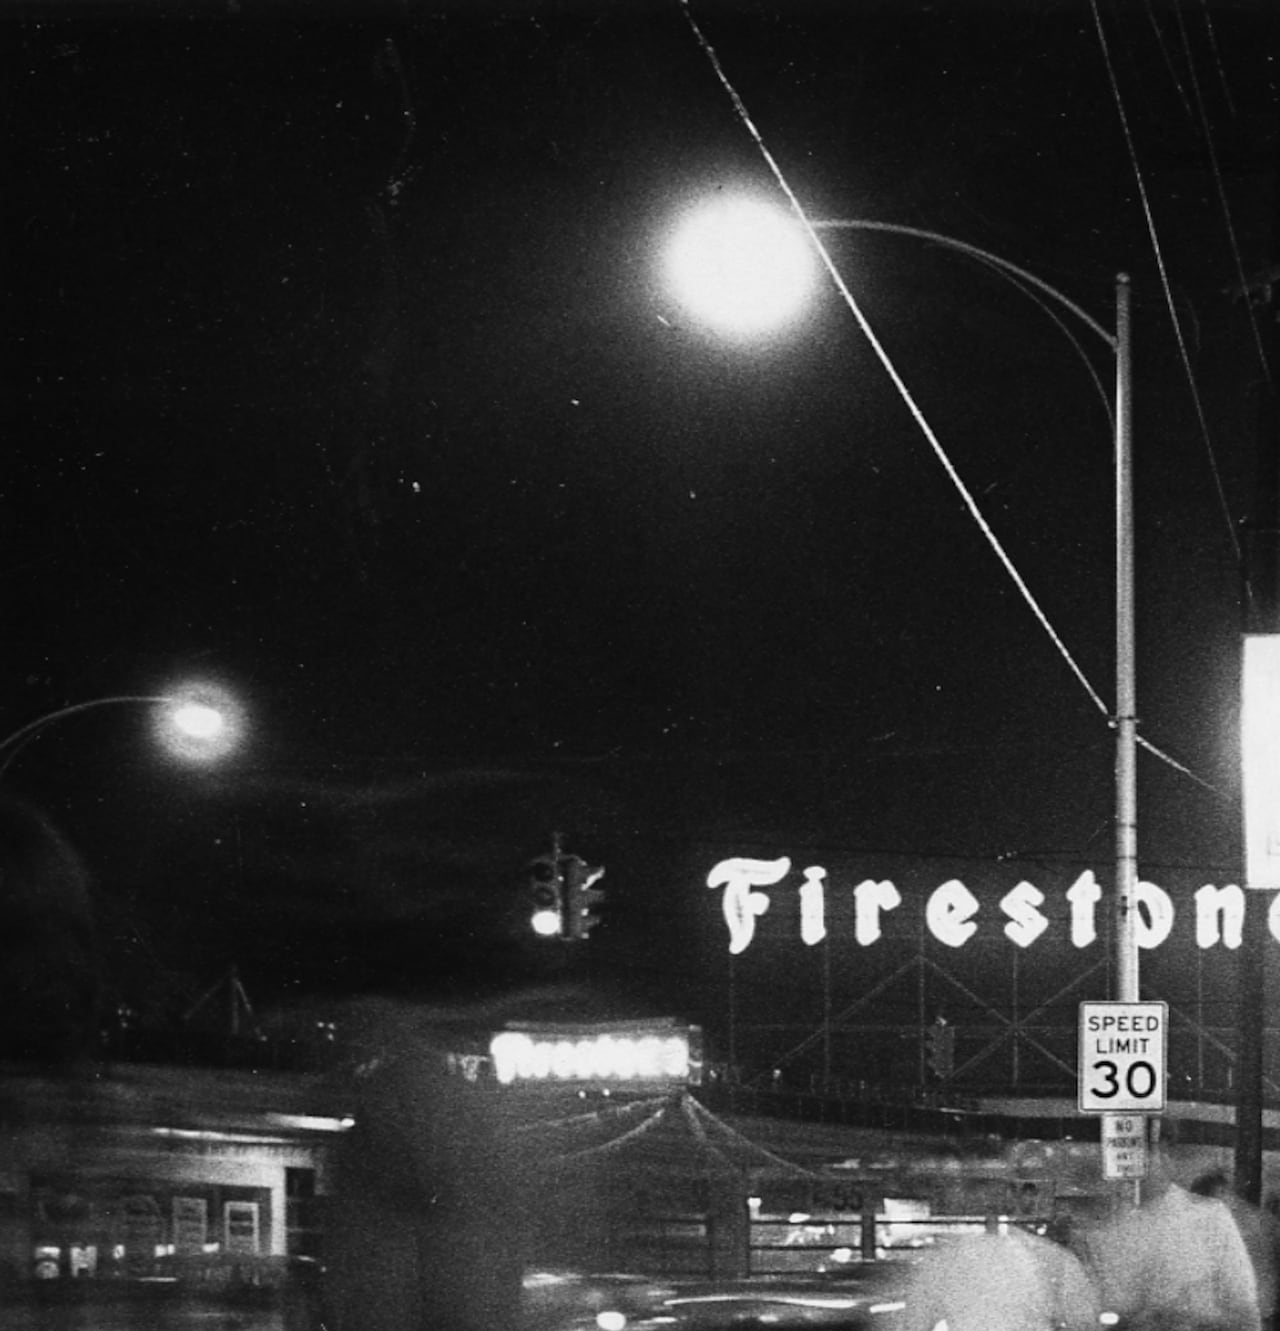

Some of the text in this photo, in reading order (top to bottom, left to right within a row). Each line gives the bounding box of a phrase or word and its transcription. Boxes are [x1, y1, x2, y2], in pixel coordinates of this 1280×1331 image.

[1088, 1016, 1160, 1032] SPEED
[1096, 1038, 1150, 1054] LIMIT
[1090, 1060, 1157, 1099] 30
